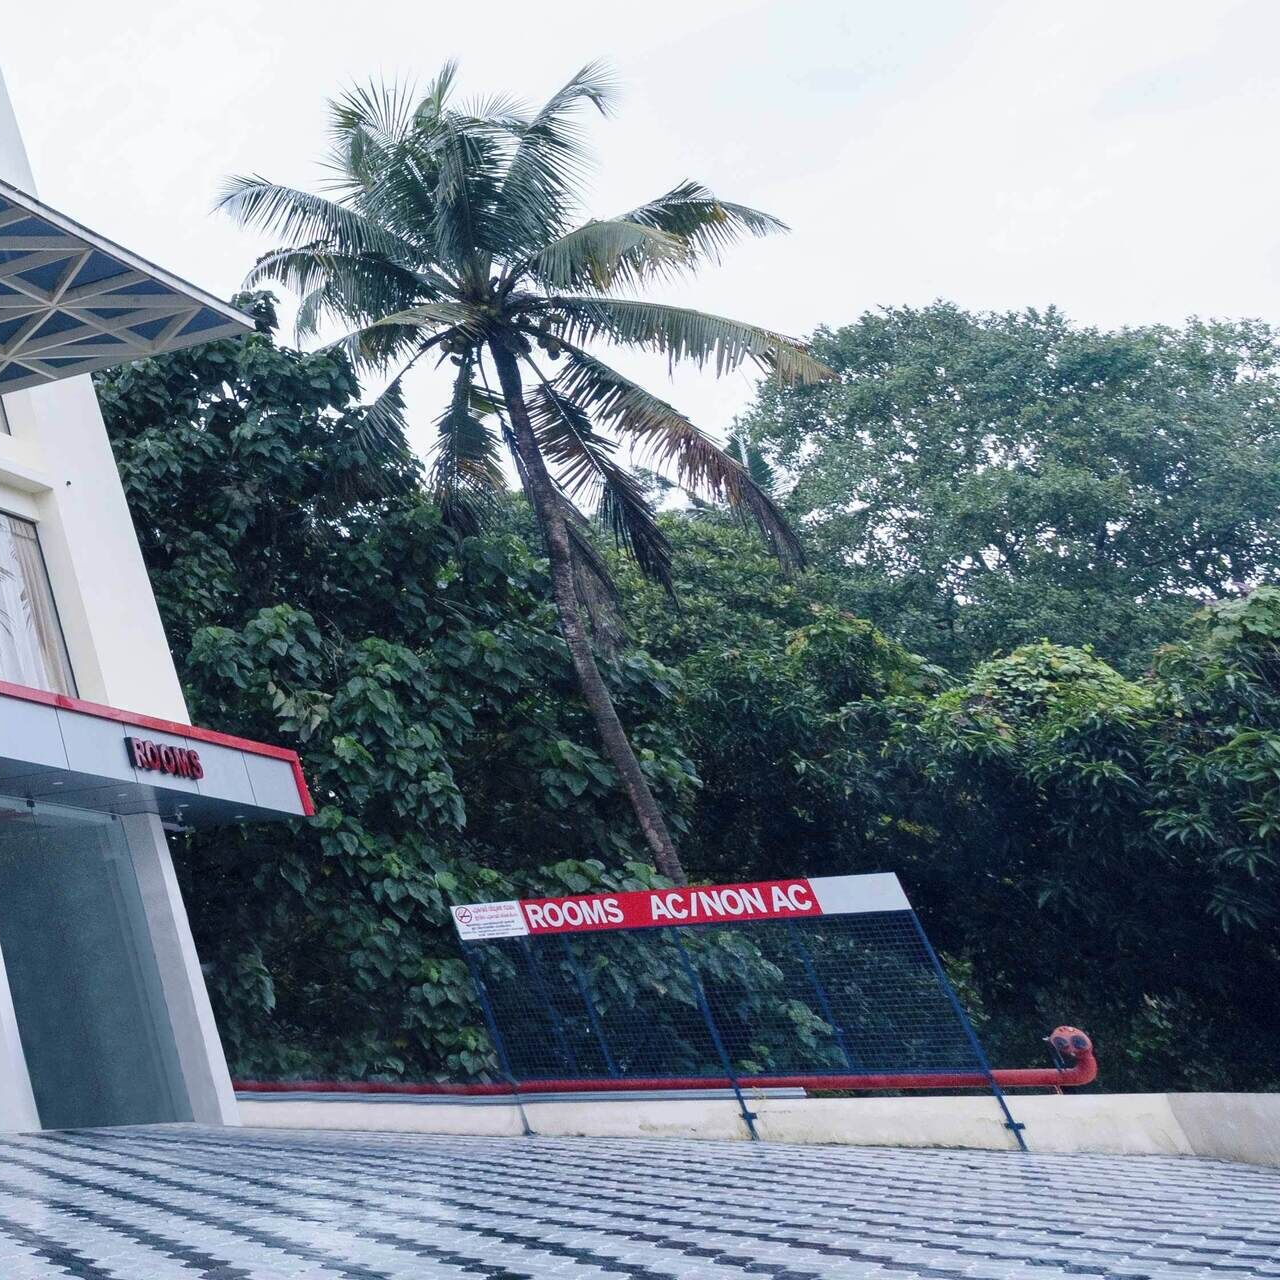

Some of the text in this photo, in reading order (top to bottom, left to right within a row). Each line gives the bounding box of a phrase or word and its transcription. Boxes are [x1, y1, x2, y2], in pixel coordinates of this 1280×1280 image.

[125, 736, 204, 780] ROOMS
[525, 898, 624, 928] ROOMS
[650, 888, 767, 920] AC/NON
[772, 884, 812, 912] AC
